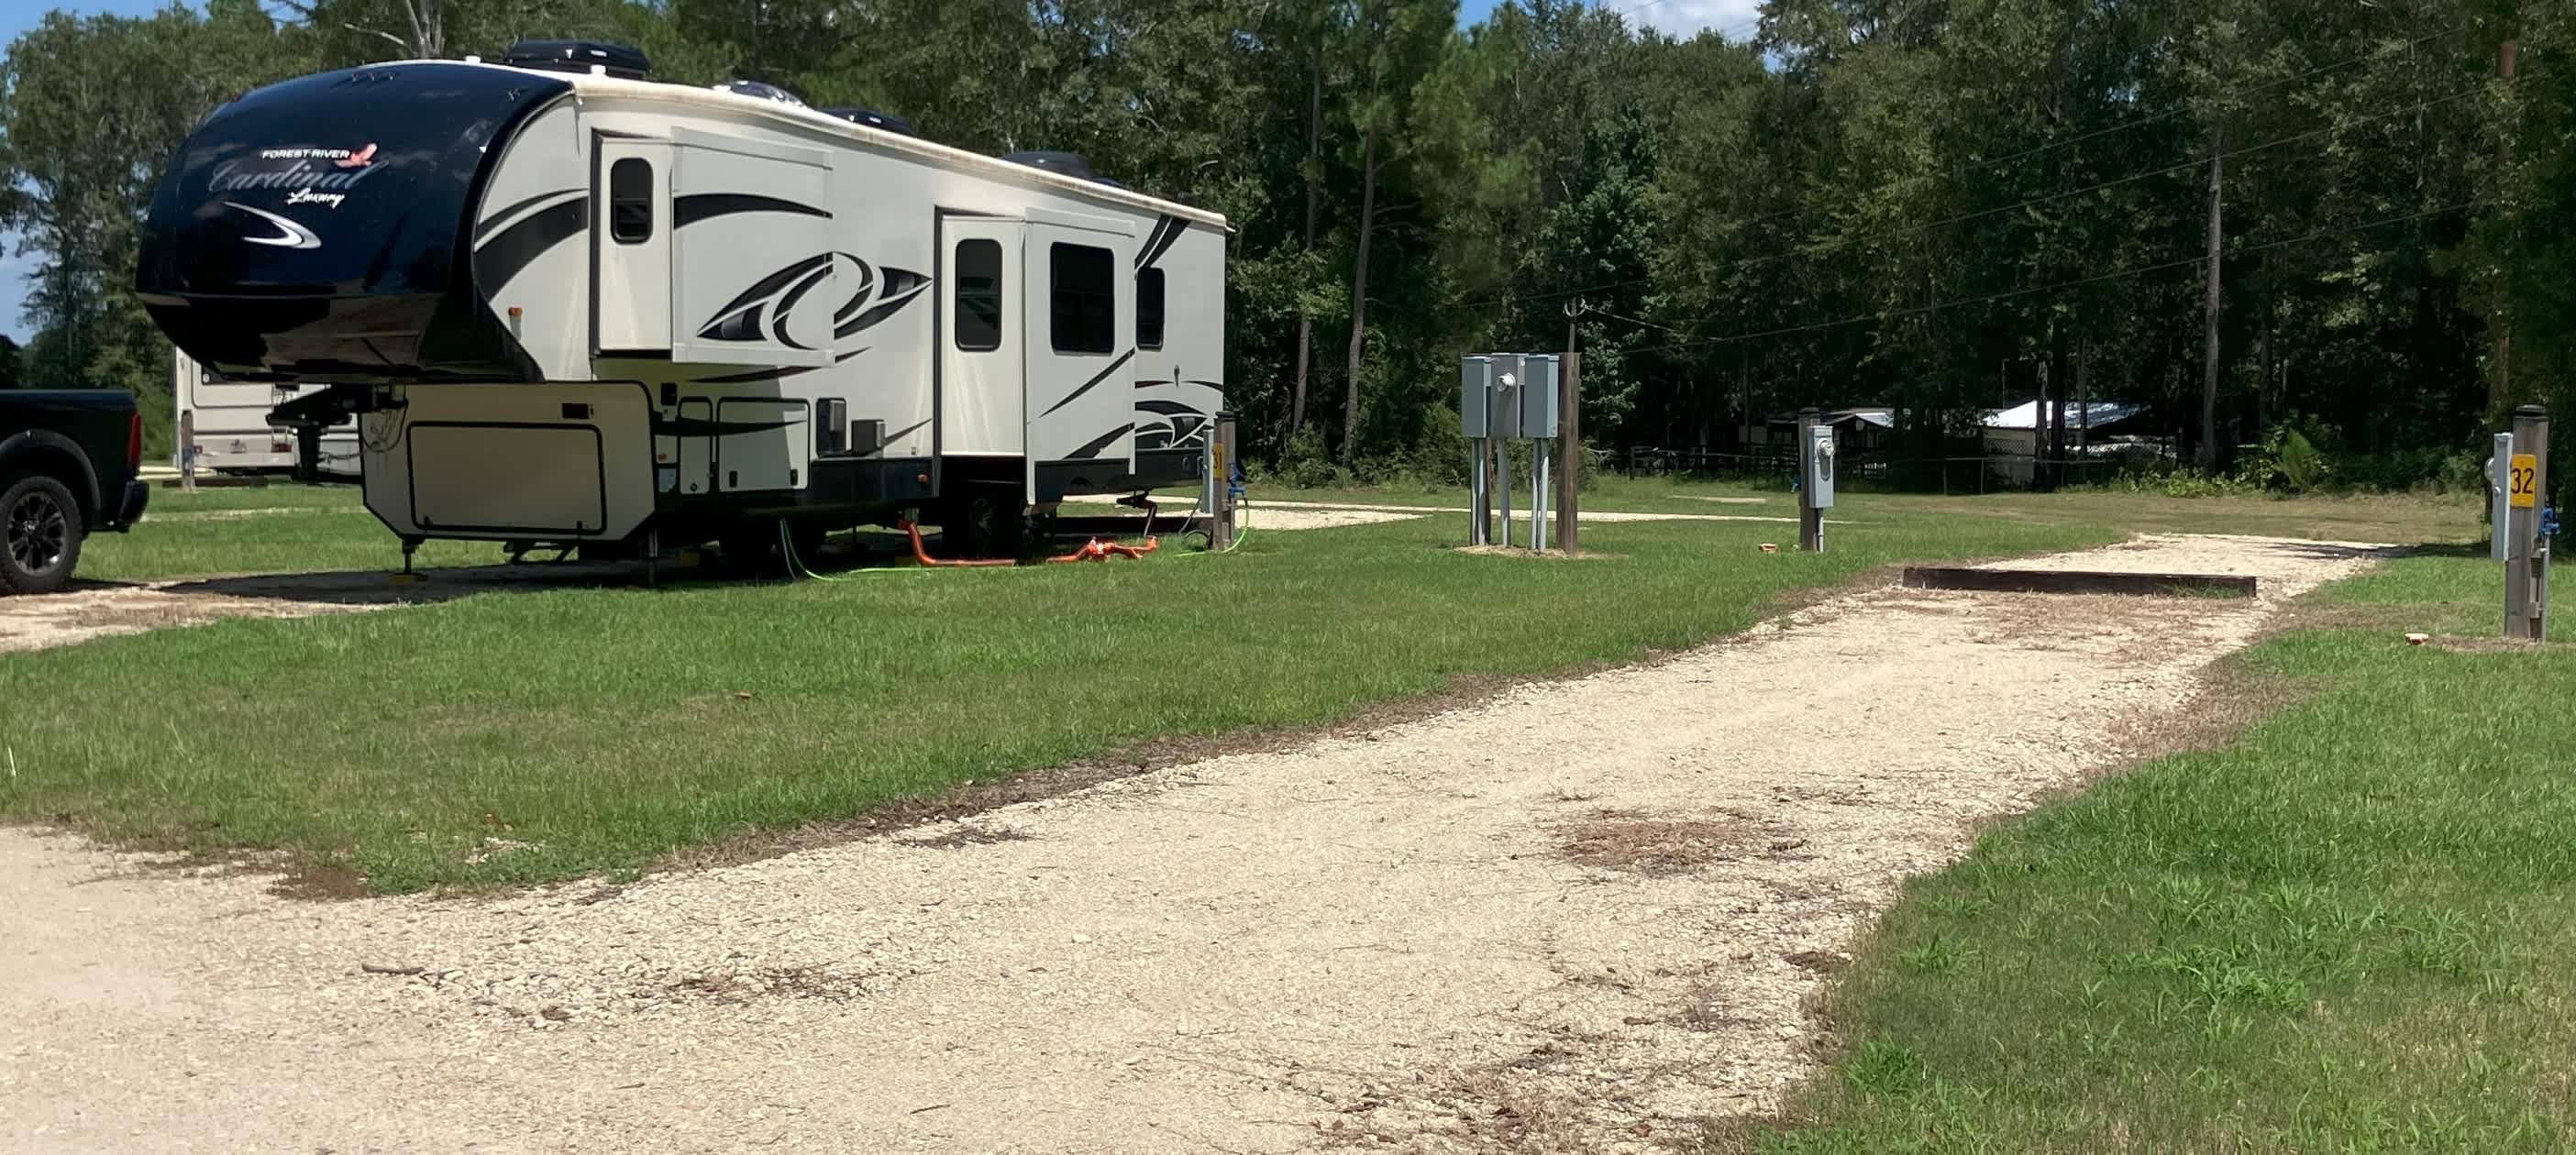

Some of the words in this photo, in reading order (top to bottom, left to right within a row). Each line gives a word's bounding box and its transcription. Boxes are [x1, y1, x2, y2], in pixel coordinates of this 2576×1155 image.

[262, 148, 309, 160] FOREST
[312, 148, 350, 159] RIVER
[208, 159, 389, 192] Cardinal
[2511, 468, 2534, 494] 32
